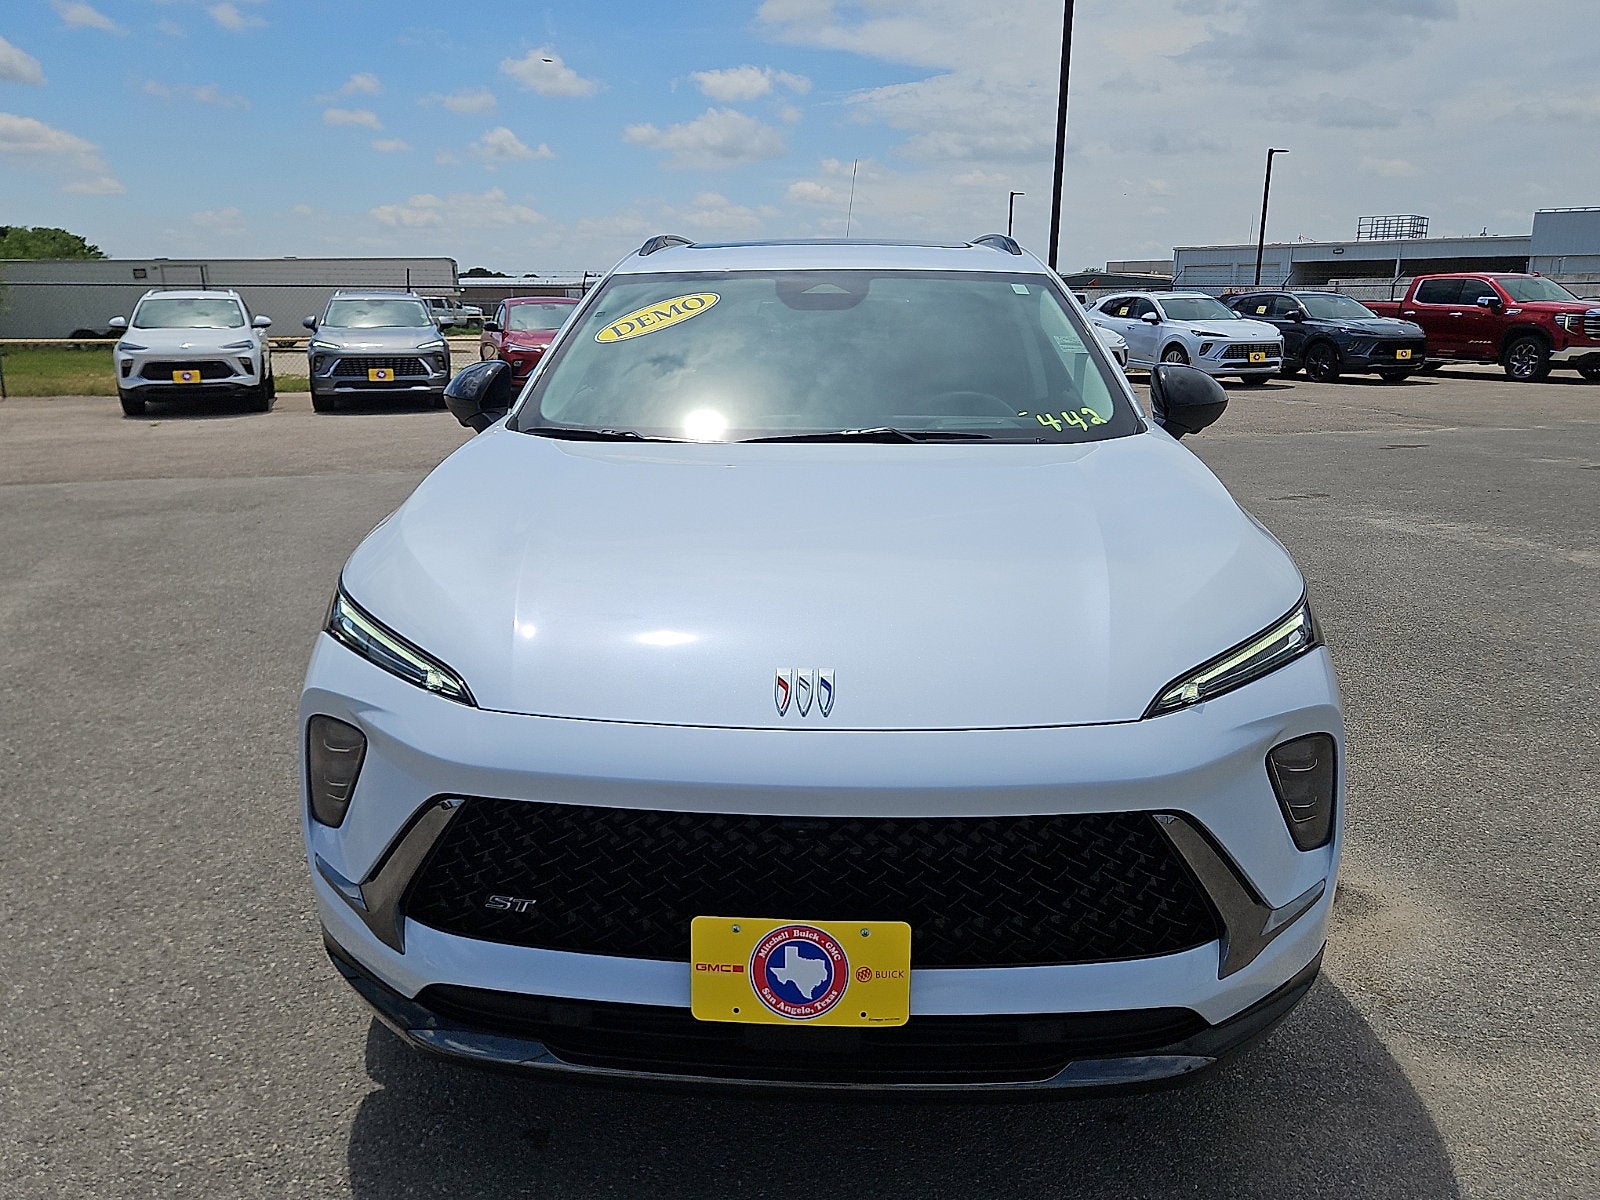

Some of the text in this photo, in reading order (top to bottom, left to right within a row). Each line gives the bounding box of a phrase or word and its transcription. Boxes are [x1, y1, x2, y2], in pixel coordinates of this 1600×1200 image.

[610, 297, 706, 337] DEMO
[485, 894, 537, 913] ST
[759, 932, 789, 958] Mitchell
[792, 929, 820, 942] Buick
[825, 941, 842, 961] GMC
[695, 963, 732, 973] GMC
[875, 970, 905, 979] BUICK
[761, 987, 838, 1015] San Angelo, Texas
